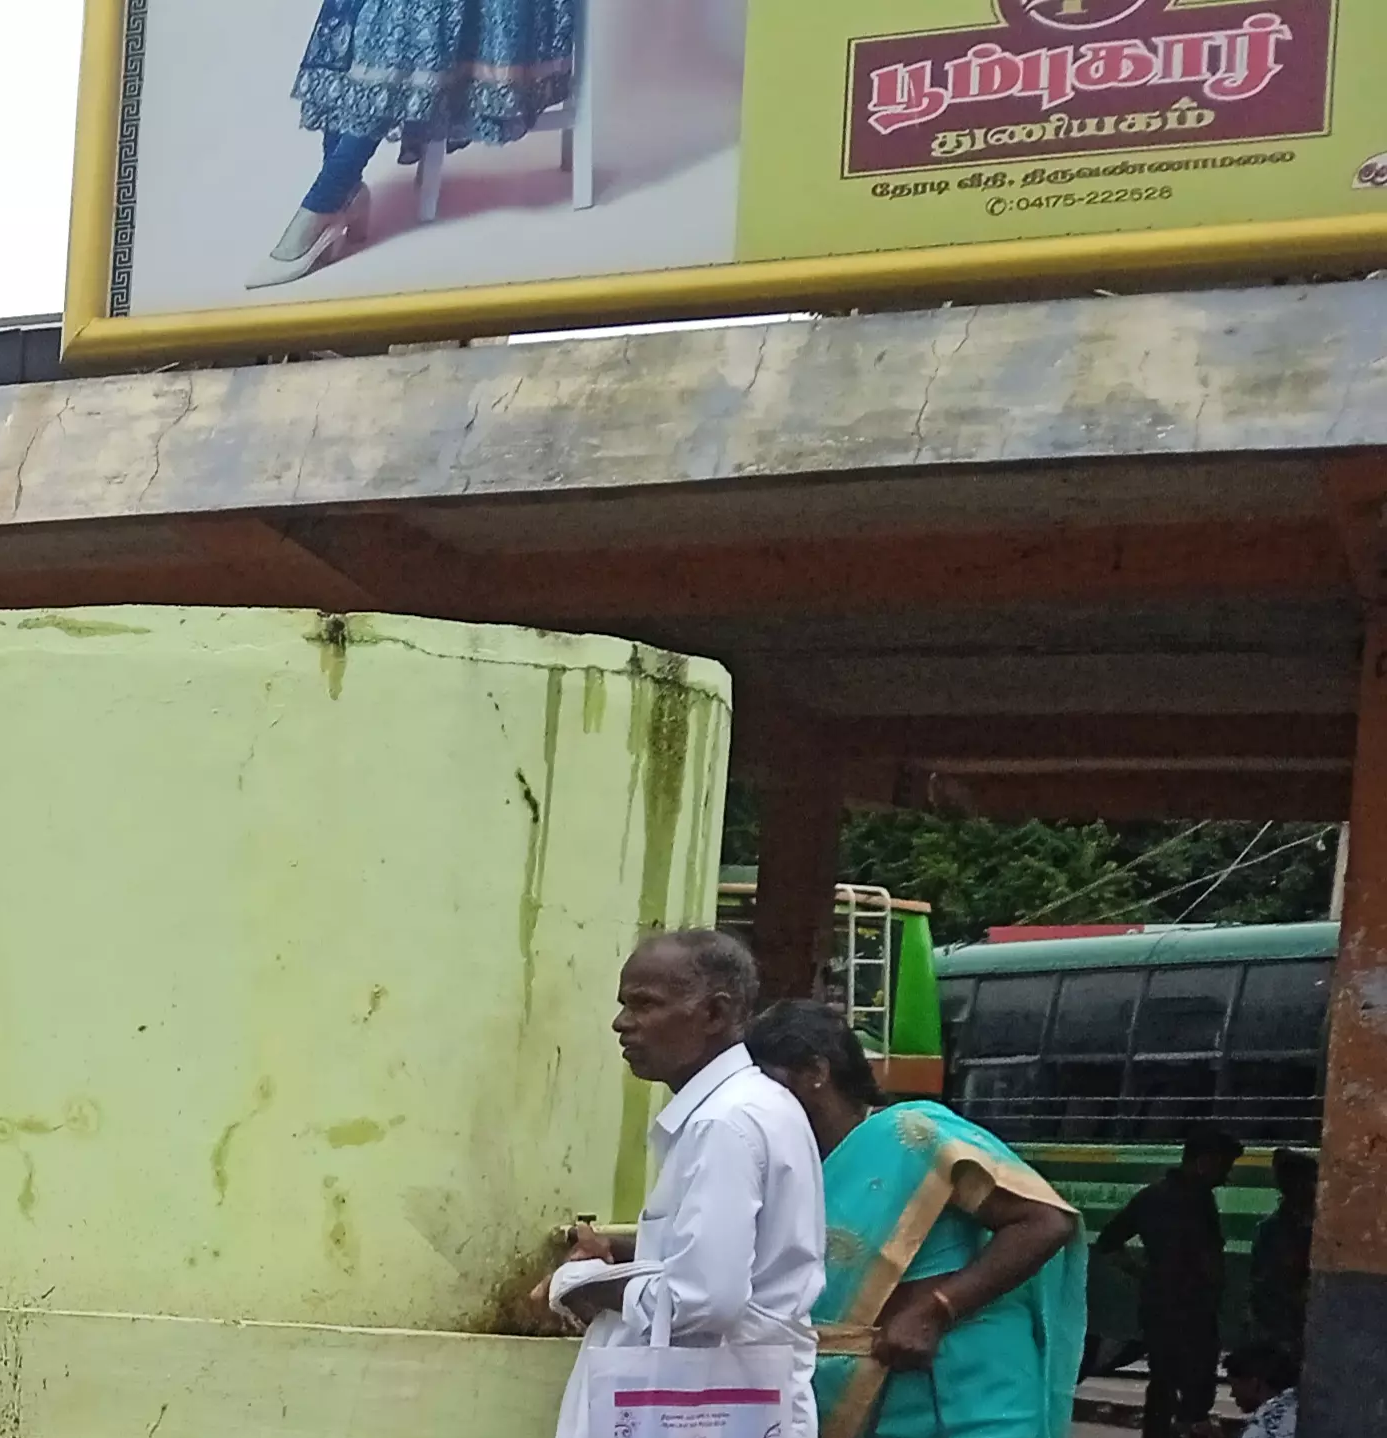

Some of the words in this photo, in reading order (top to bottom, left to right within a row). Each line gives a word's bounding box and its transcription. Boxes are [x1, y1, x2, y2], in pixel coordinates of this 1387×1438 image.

[867, 13, 1292, 135] பூம்புகார்
[930, 95, 1215, 157] துணியகம்
[1020, 149, 1295, 188] திருவண்ணாமலை
